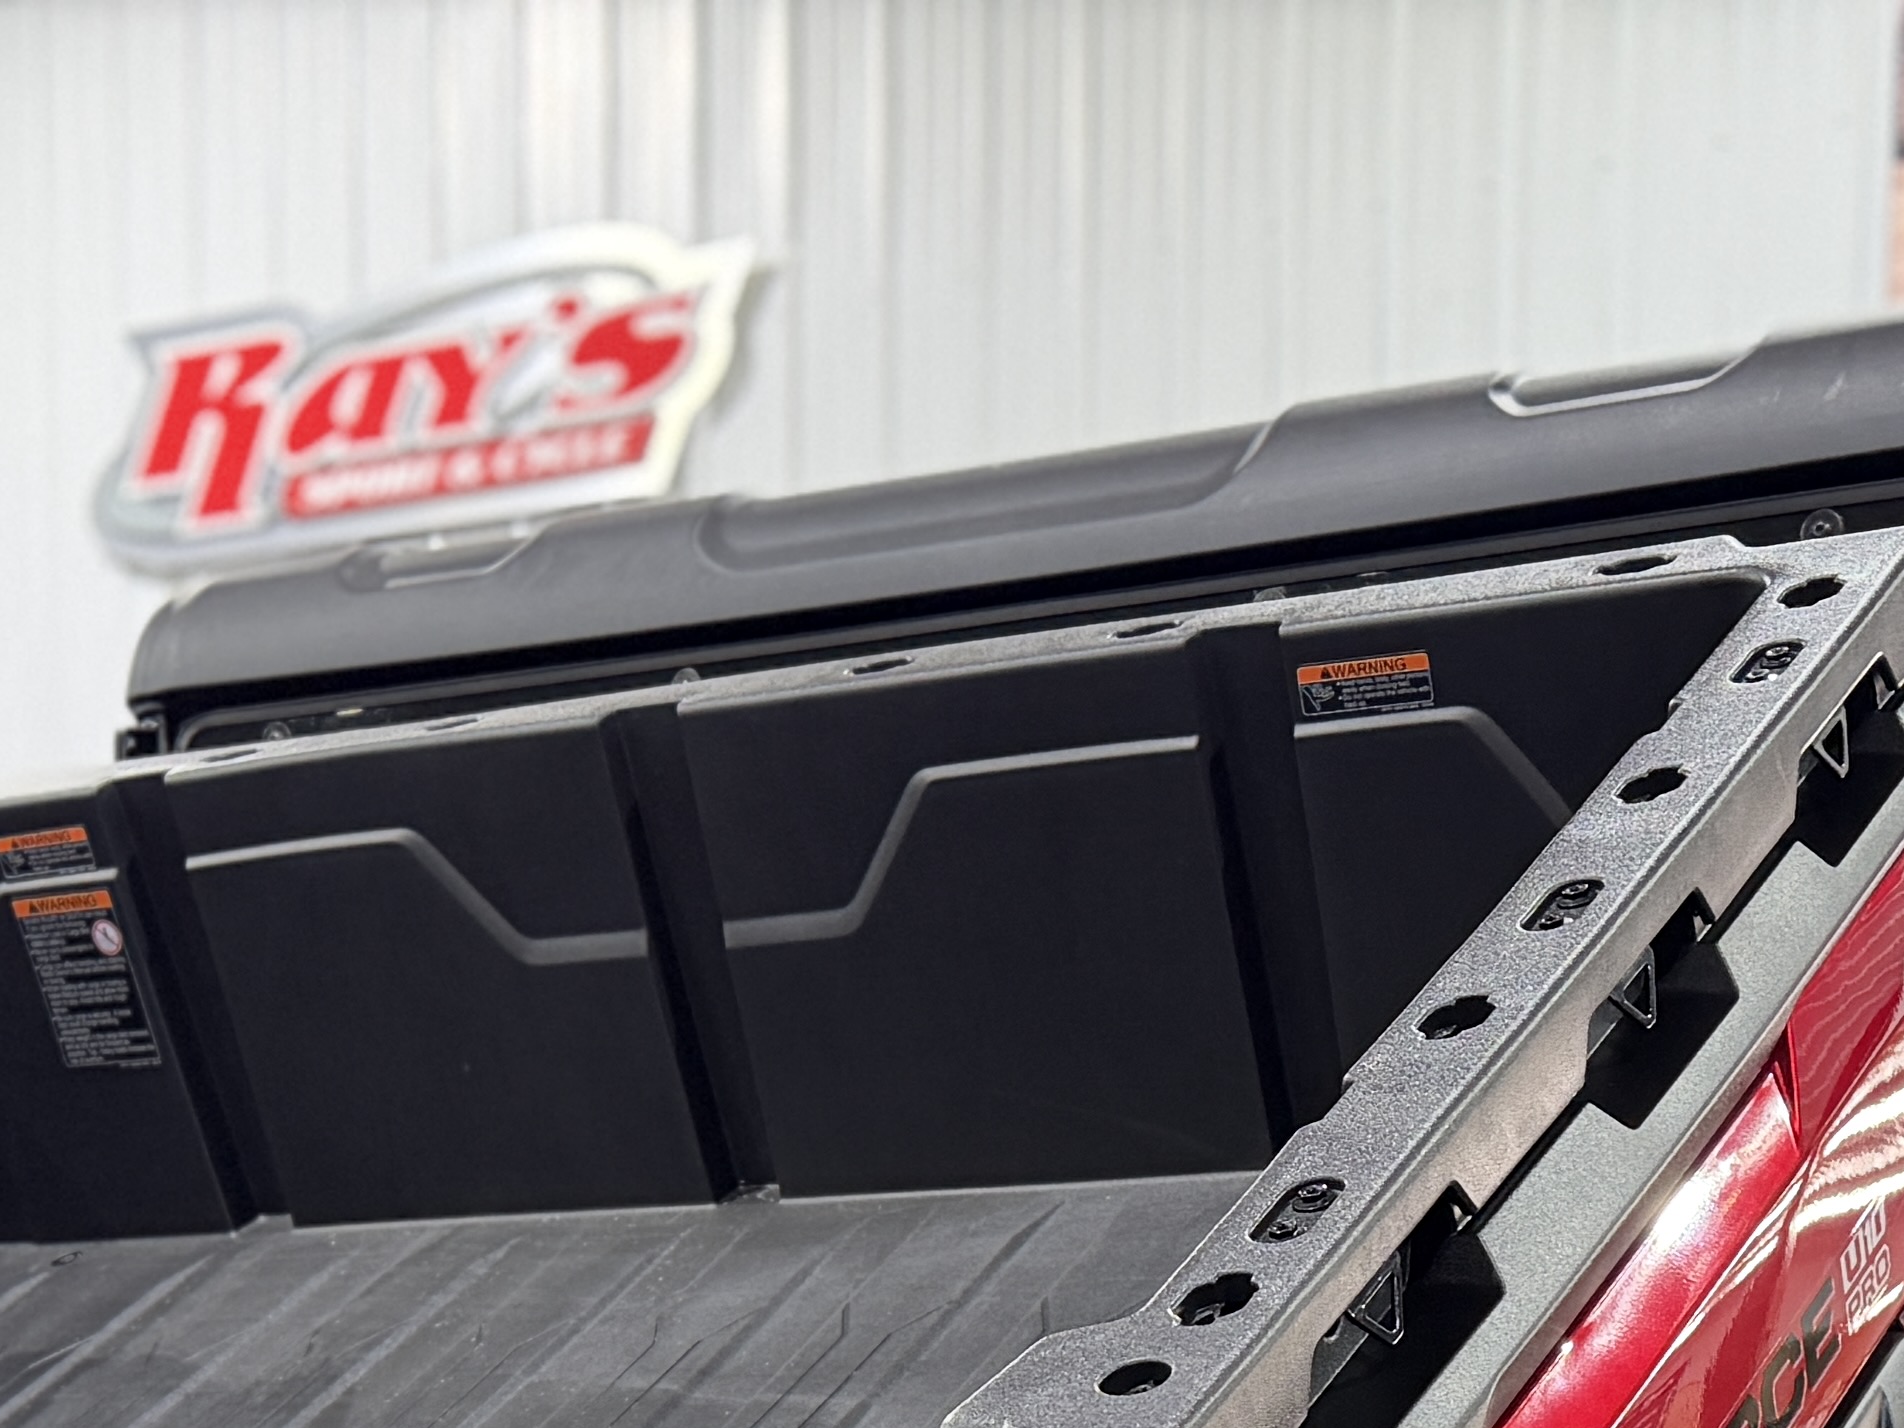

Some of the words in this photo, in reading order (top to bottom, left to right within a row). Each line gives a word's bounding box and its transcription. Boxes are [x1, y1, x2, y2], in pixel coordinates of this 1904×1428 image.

[1332, 657, 1408, 679] WARNING
[18, 830, 72, 849] WARNING
[38, 893, 97, 914] WARNING
[1841, 1194, 1887, 1295] U10
[1846, 1243, 1892, 1336] PRO
